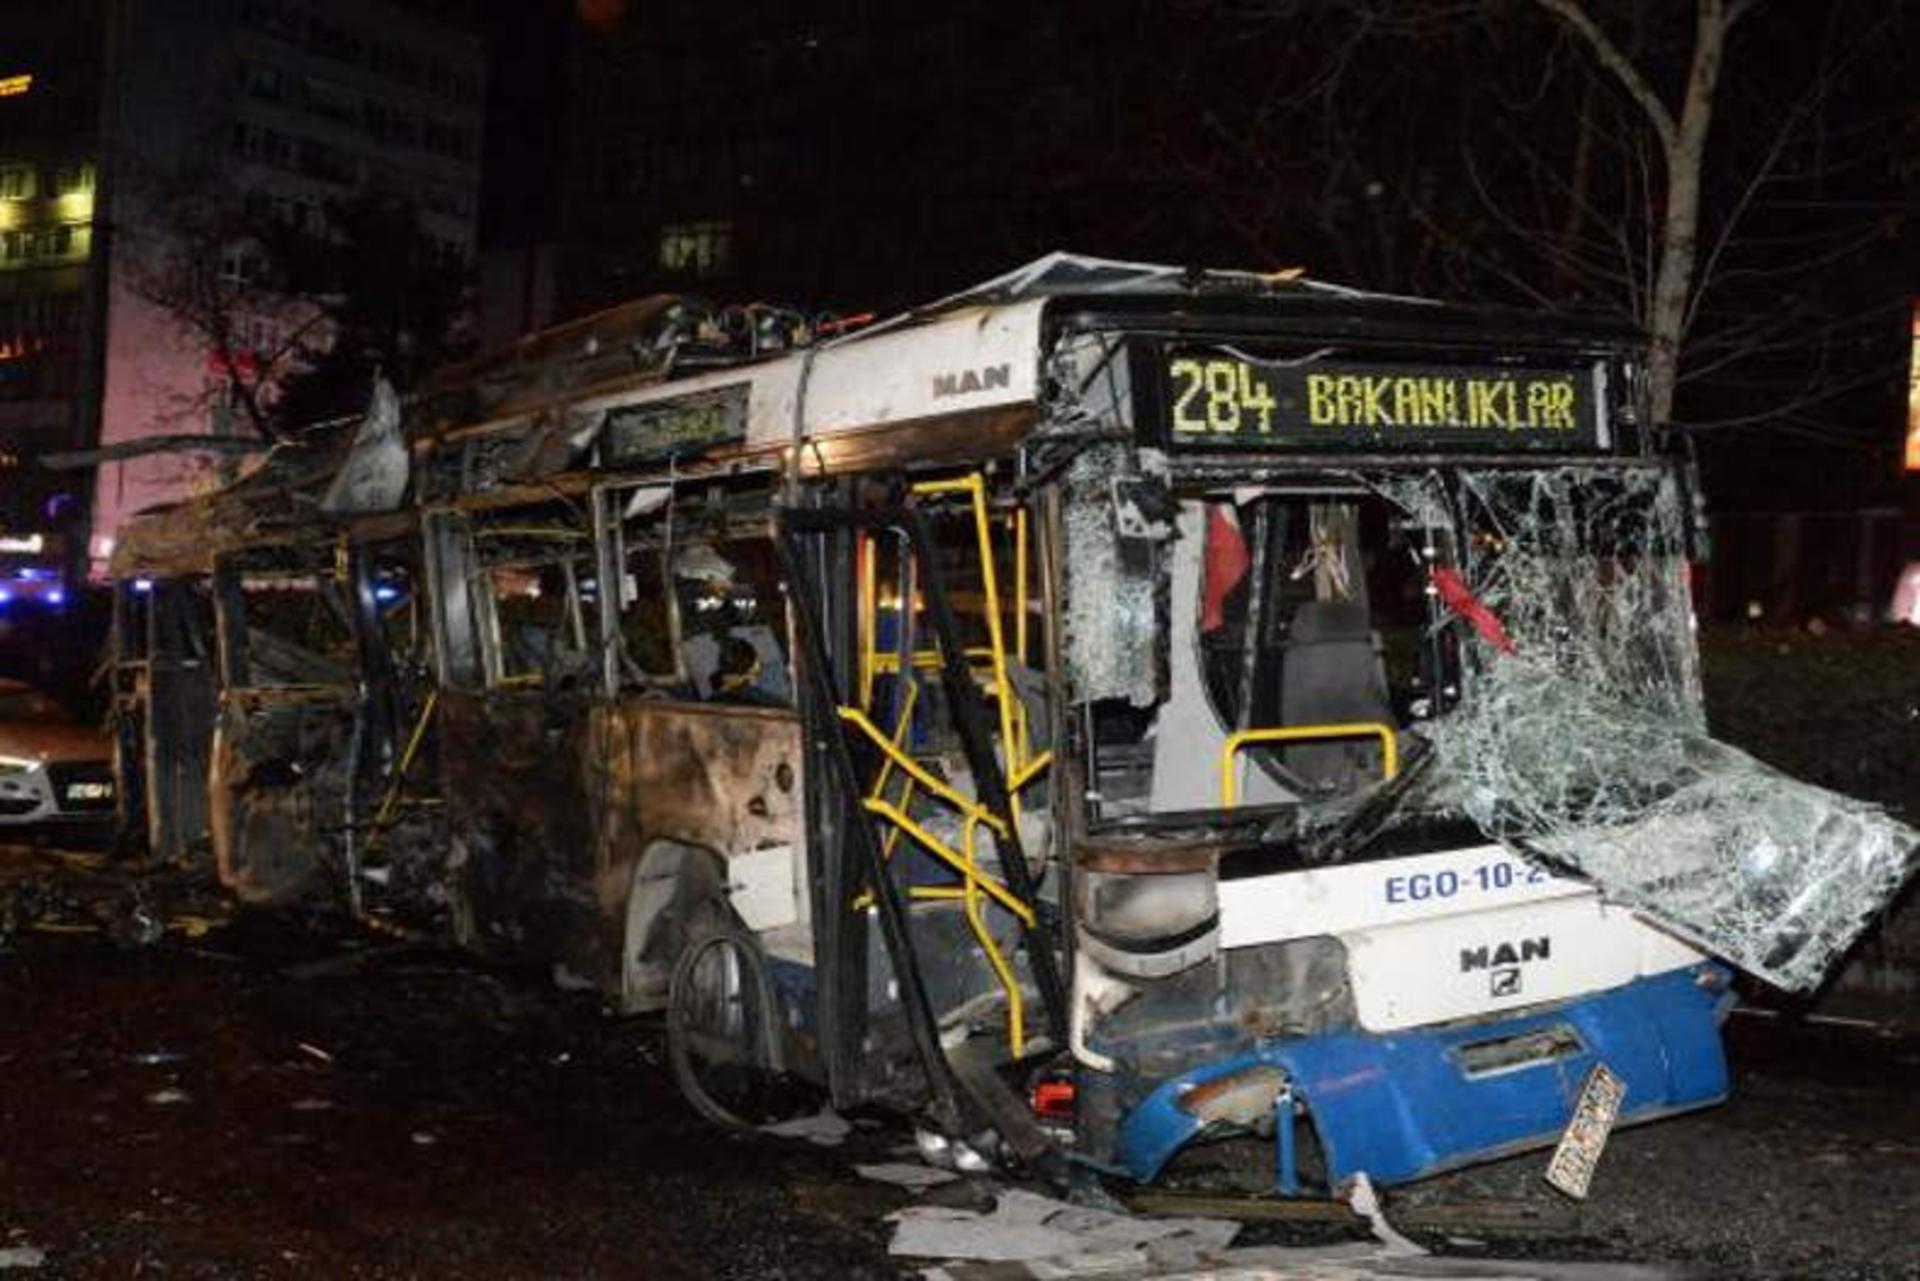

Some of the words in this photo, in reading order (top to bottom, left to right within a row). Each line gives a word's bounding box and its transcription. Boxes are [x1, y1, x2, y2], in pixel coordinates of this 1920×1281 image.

[933, 364, 1010, 399] MAN
[1170, 359, 1276, 433] 284
[1307, 374, 1576, 430] BAKANLIKLAR
[1386, 861, 1562, 902] EGO-10-2
[1461, 937, 1550, 972] MAN
